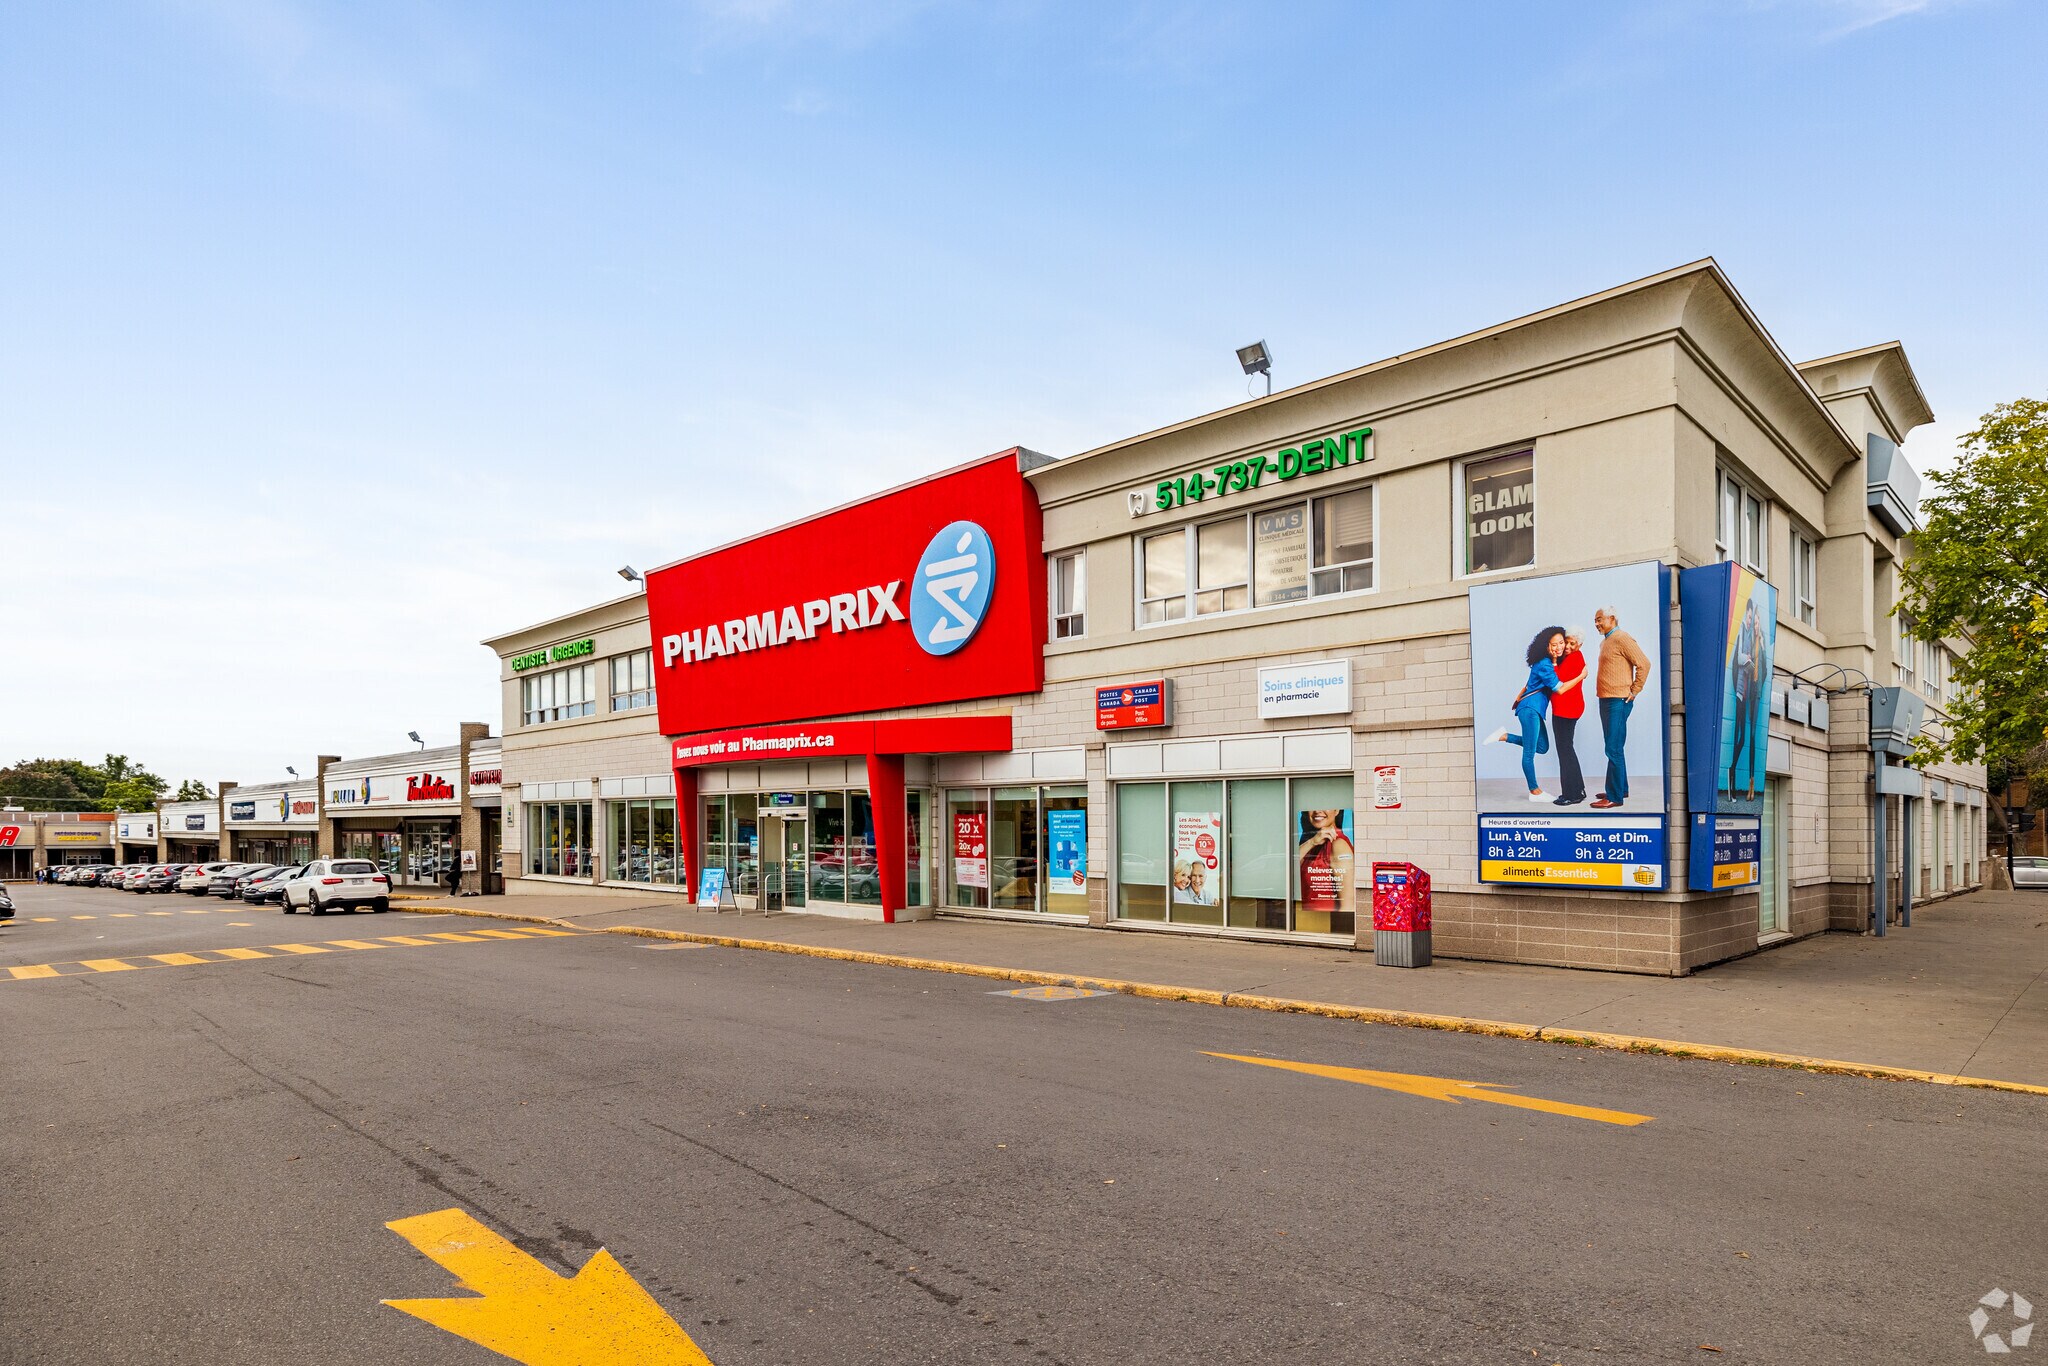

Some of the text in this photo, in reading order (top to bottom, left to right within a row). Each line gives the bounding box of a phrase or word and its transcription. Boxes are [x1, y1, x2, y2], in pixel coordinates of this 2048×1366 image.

[1155, 427, 1373, 510] 514-737-DENT
[1469, 483, 1533, 515] GLAM
[1469, 511, 1533, 538] LOOK
[1259, 527, 1305, 542] CLINIQUE MÉDICALE
[1282, 543, 1306, 553] FAMILIALE
[662, 580, 905, 668] PHARMAPRIX
[511, 639, 594, 672] DENTISTE URGENCE
[1264, 676, 1344, 692] Soins cliniques
[1264, 690, 1320, 703] en pharmacie
[692, 746, 708, 758] nous
[709, 740, 726, 755] voir
[727, 741, 740, 753] au
[742, 733, 834, 753] Pharmaprix.ca
[828, 817, 839, 826] Vive
[958, 822, 980, 834] 20 x
[1488, 831, 1548, 842] Lun. à Ven.
[1575, 832, 1653, 843] Sam. et Dim.
[958, 842, 971, 850] 20x
[1488, 846, 1541, 858] 8h à 22h
[1575, 848, 1634, 860] 9h à 22h
[1307, 866, 1333, 874] Relevez
